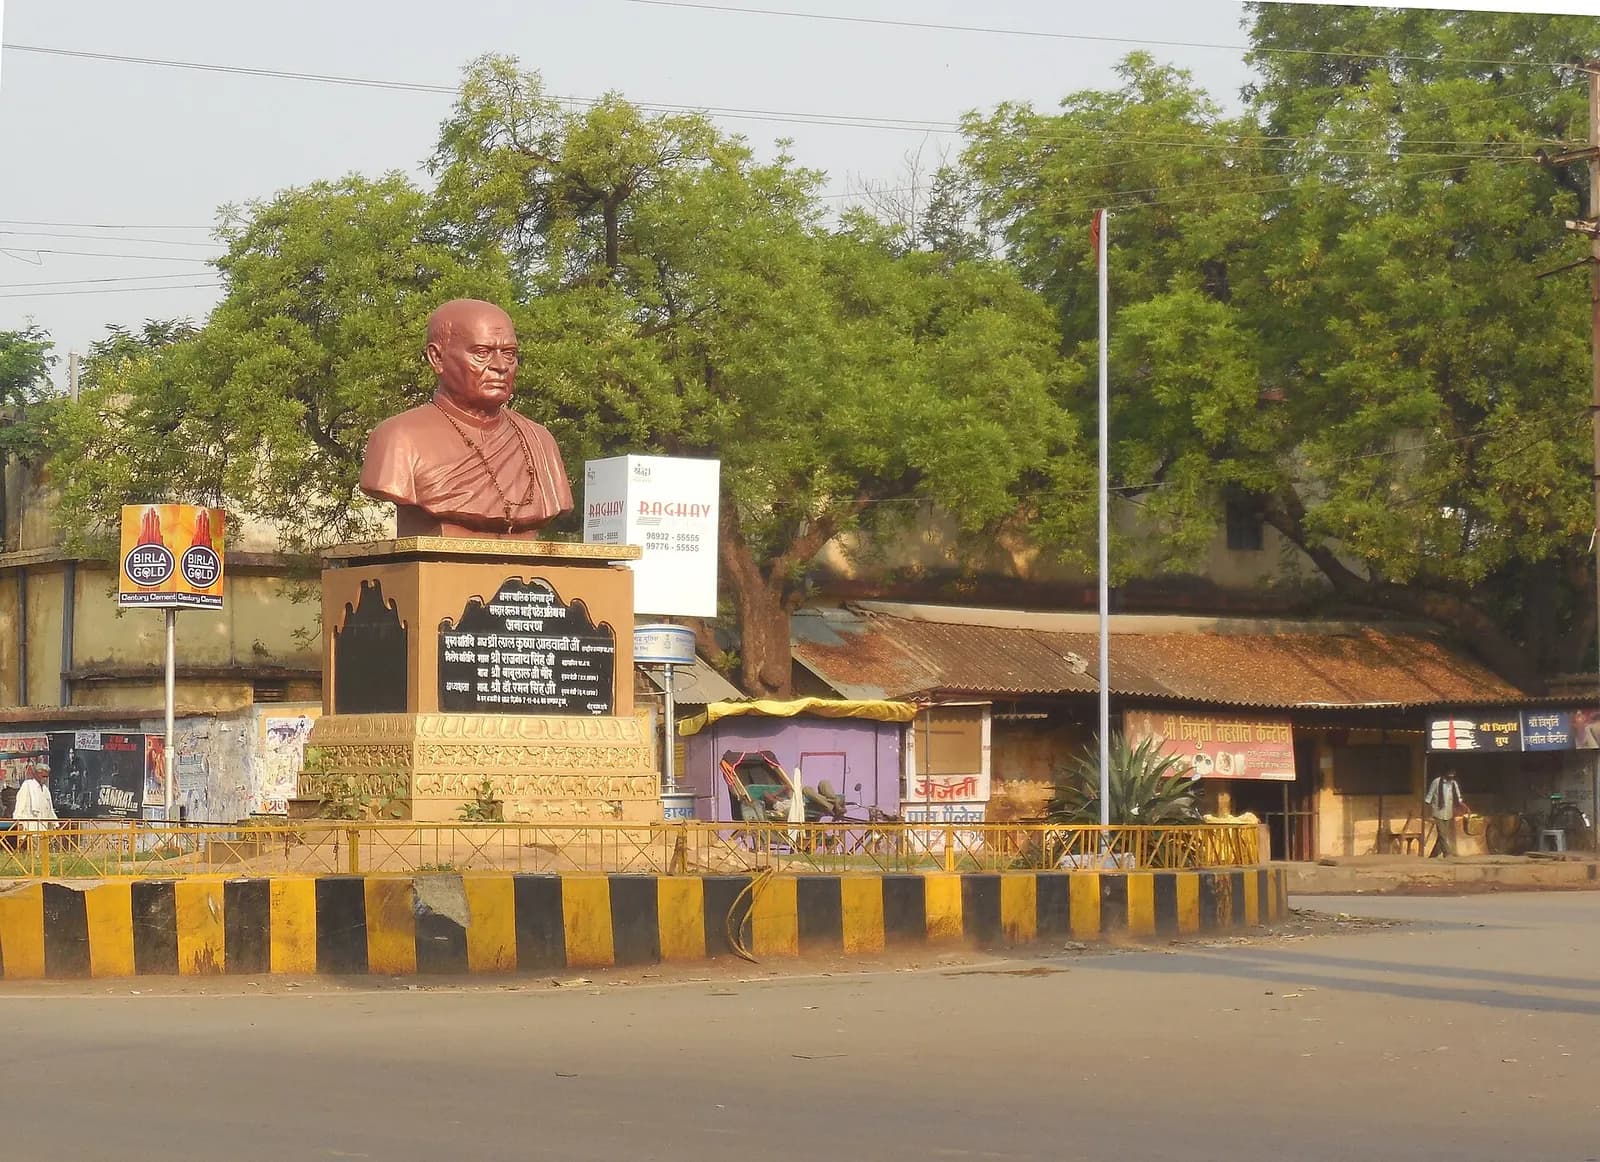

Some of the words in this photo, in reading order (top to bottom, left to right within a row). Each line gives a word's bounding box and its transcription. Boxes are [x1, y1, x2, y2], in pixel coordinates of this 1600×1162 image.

[588, 500, 624, 518] RAGHAV
[638, 500, 711, 519] RAGHAV
[646, 531, 670, 541] 98932
[676, 533, 700, 543] 55555
[646, 542, 670, 551] 99776
[676, 543, 700, 553] 55555
[133, 552, 167, 563] BIRLA
[187, 553, 215, 567] BIRLA
[133, 566, 166, 579] GOLD
[187, 567, 214, 580] GOLD
[121, 593, 149, 602] Century
[149, 593, 177, 601] Cement
[177, 593, 201, 603] Century
[200, 595, 222, 604] Cement
[505, 618, 544, 633] अनावरण
[487, 634, 498, 649] श्री
[498, 636, 516, 649] लाल
[490, 649, 501, 664] श्री
[501, 652, 531, 665] राजनाथ
[530, 651, 546, 666] सिंह
[545, 652, 556, 666] जी
[490, 664, 501, 678] श्री
[490, 679, 501, 693] श्री
[529, 680, 545, 696] सिंह
[545, 680, 557, 695] जी
[1480, 721, 1491, 731] श्री
[1528, 714, 1539, 728] श्री
[1163, 715, 1176, 741] श्री
[1216, 721, 1252, 744] तहसील
[98, 787, 135, 809] SAMRAT
